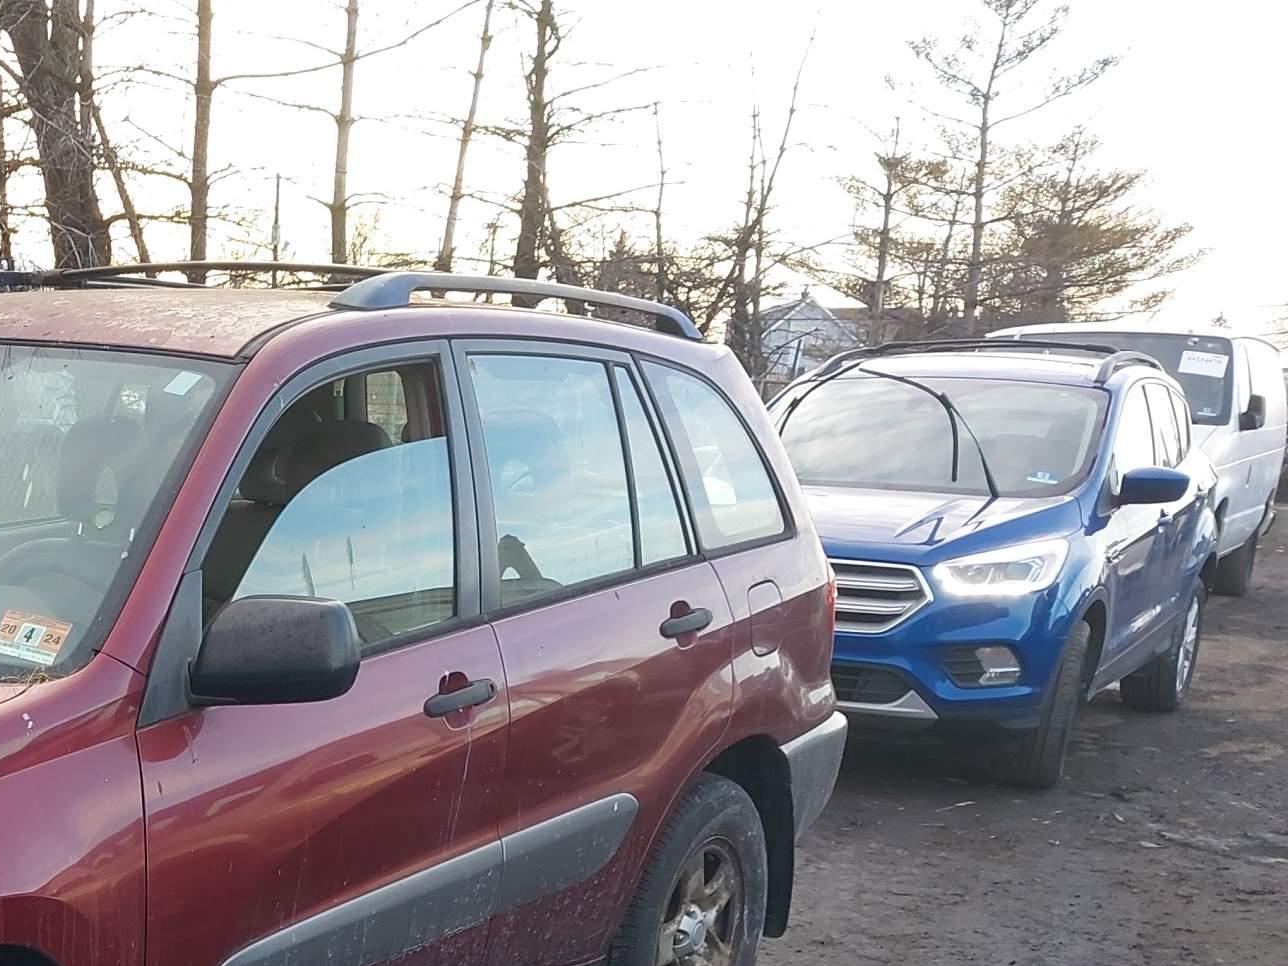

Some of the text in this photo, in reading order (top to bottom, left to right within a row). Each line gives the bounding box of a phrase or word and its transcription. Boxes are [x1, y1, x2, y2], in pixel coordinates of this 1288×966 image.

[0, 623, 61, 645] 20 4 24
